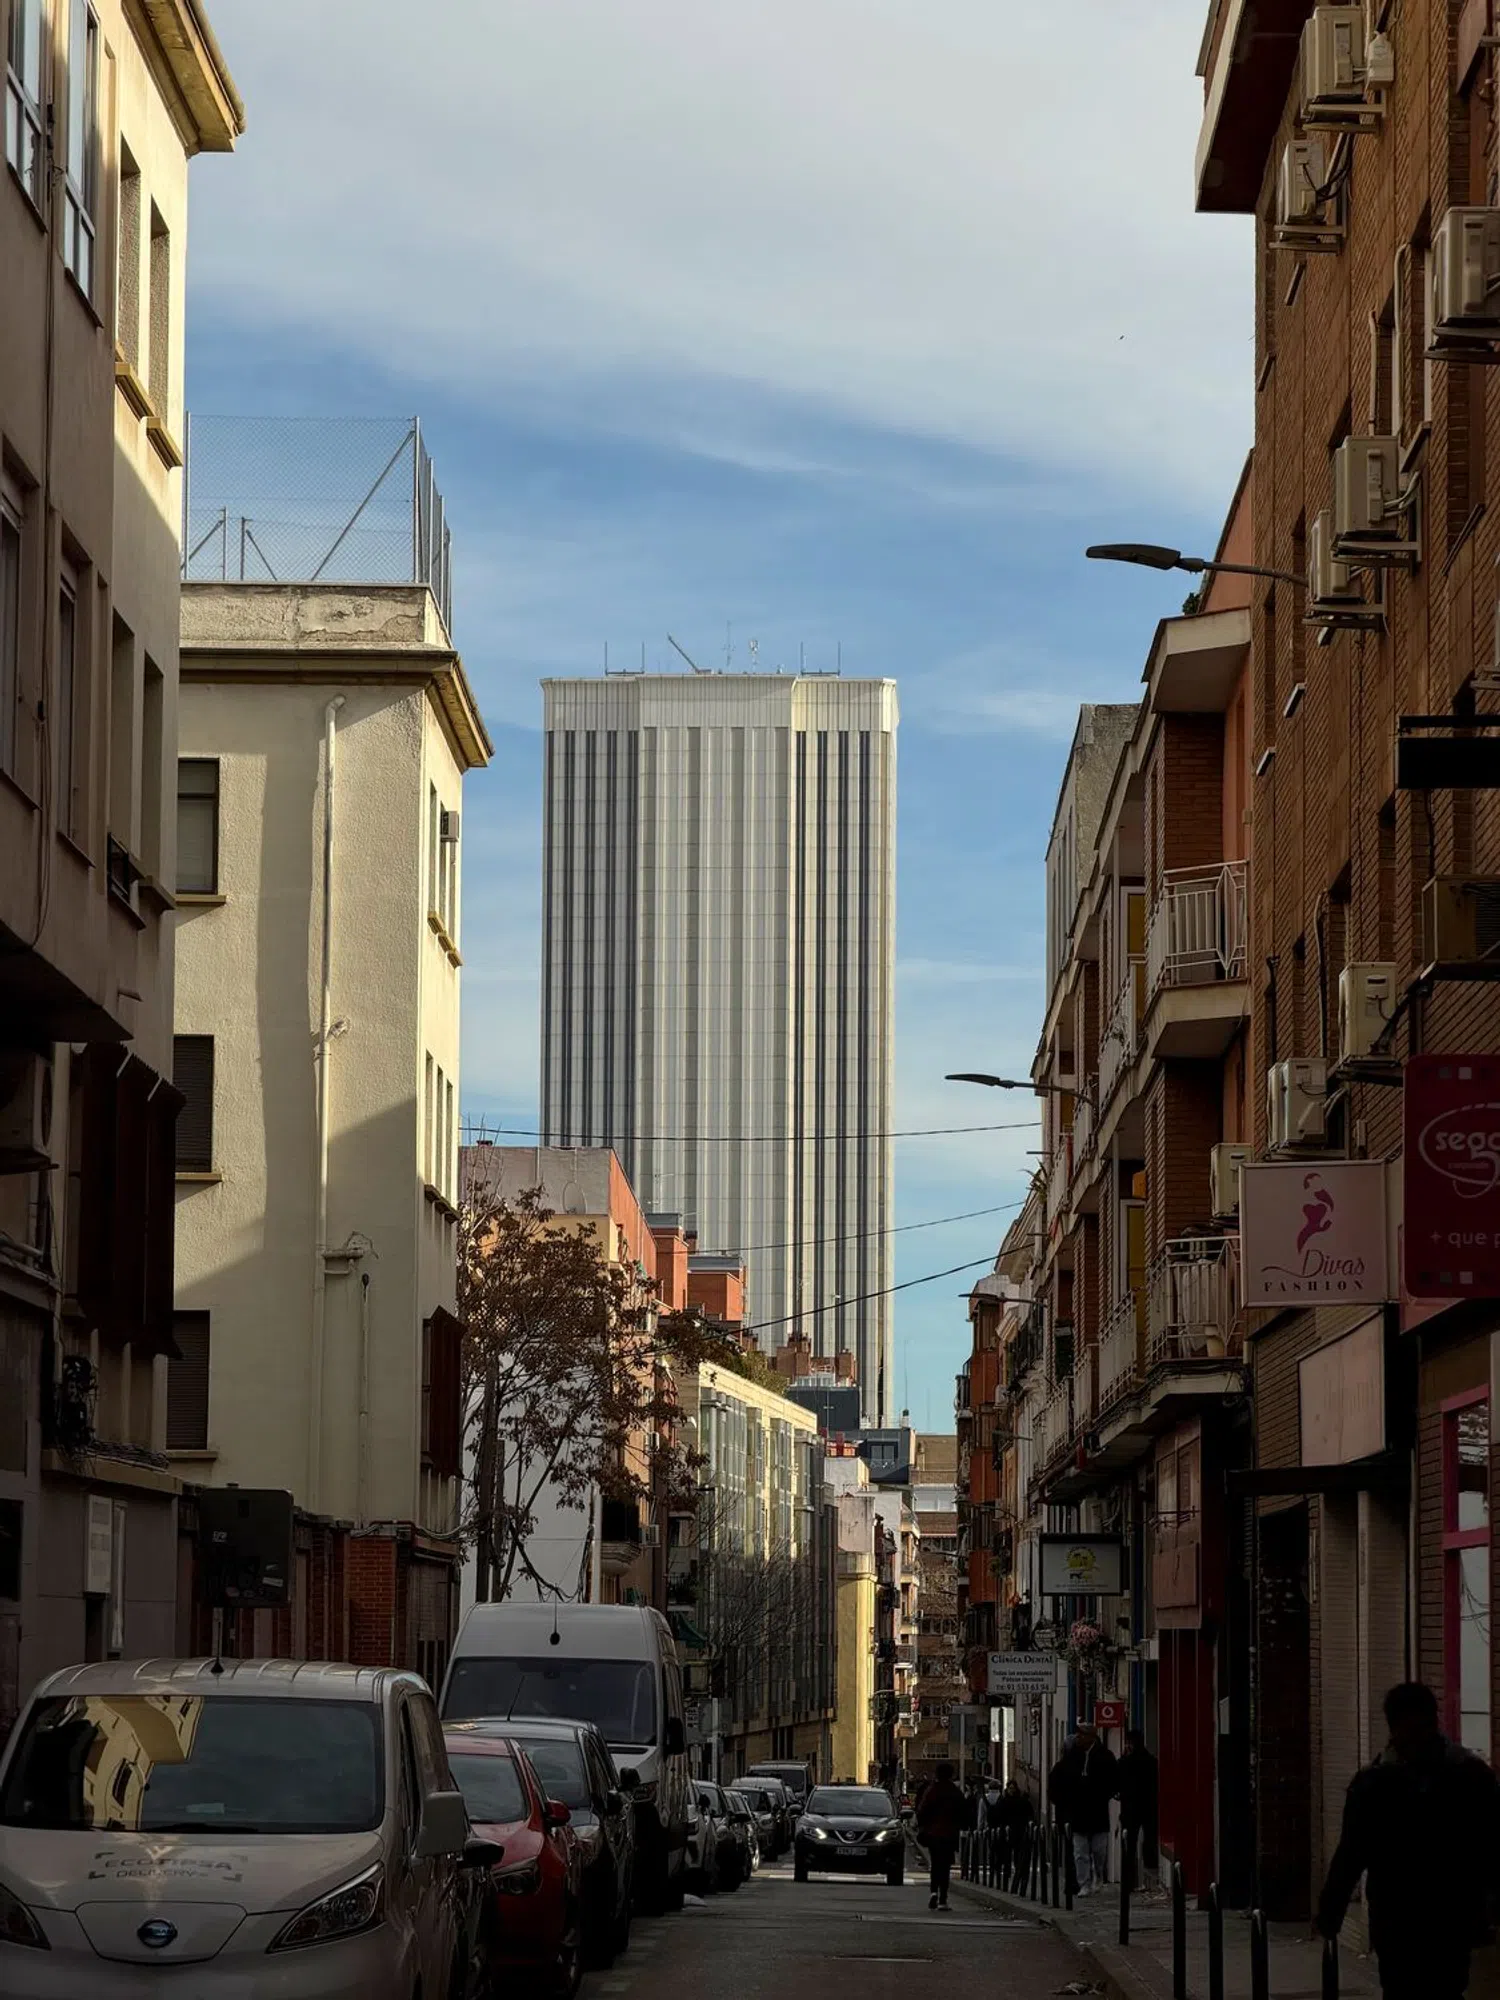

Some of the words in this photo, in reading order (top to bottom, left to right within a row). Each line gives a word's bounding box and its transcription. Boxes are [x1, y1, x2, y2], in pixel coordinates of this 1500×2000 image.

[1448, 1231, 1487, 1248] que
[1262, 1249, 1365, 1279] Divas
[1263, 1280, 1364, 1292] FASHION
